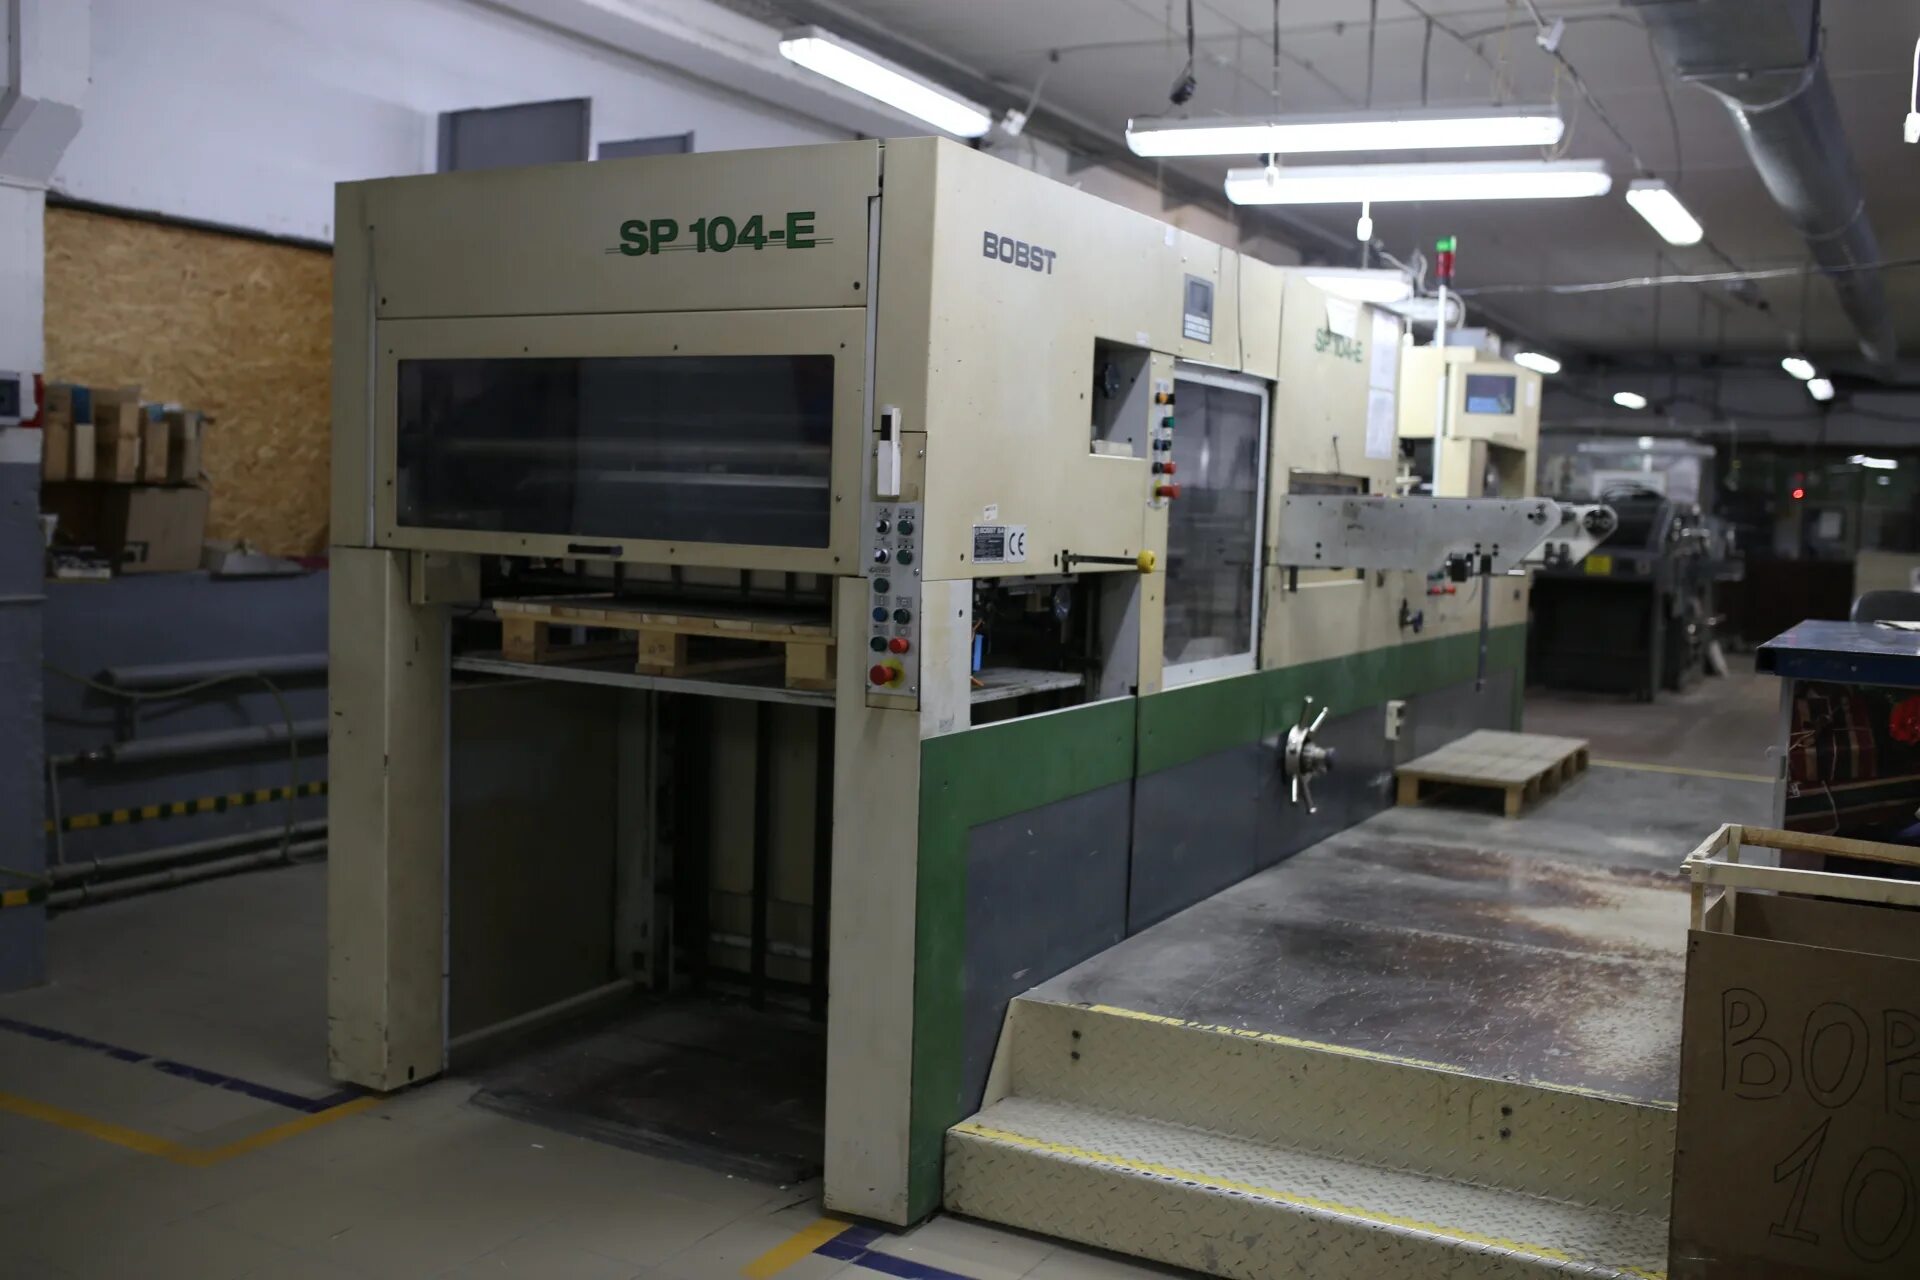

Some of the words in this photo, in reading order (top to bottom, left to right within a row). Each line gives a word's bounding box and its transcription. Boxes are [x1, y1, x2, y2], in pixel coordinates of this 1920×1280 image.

[619, 218, 679, 257] SP
[688, 211, 816, 253] 104-E
[983, 230, 1057, 275] BOBST
[1768, 1115, 1917, 1263] 10
